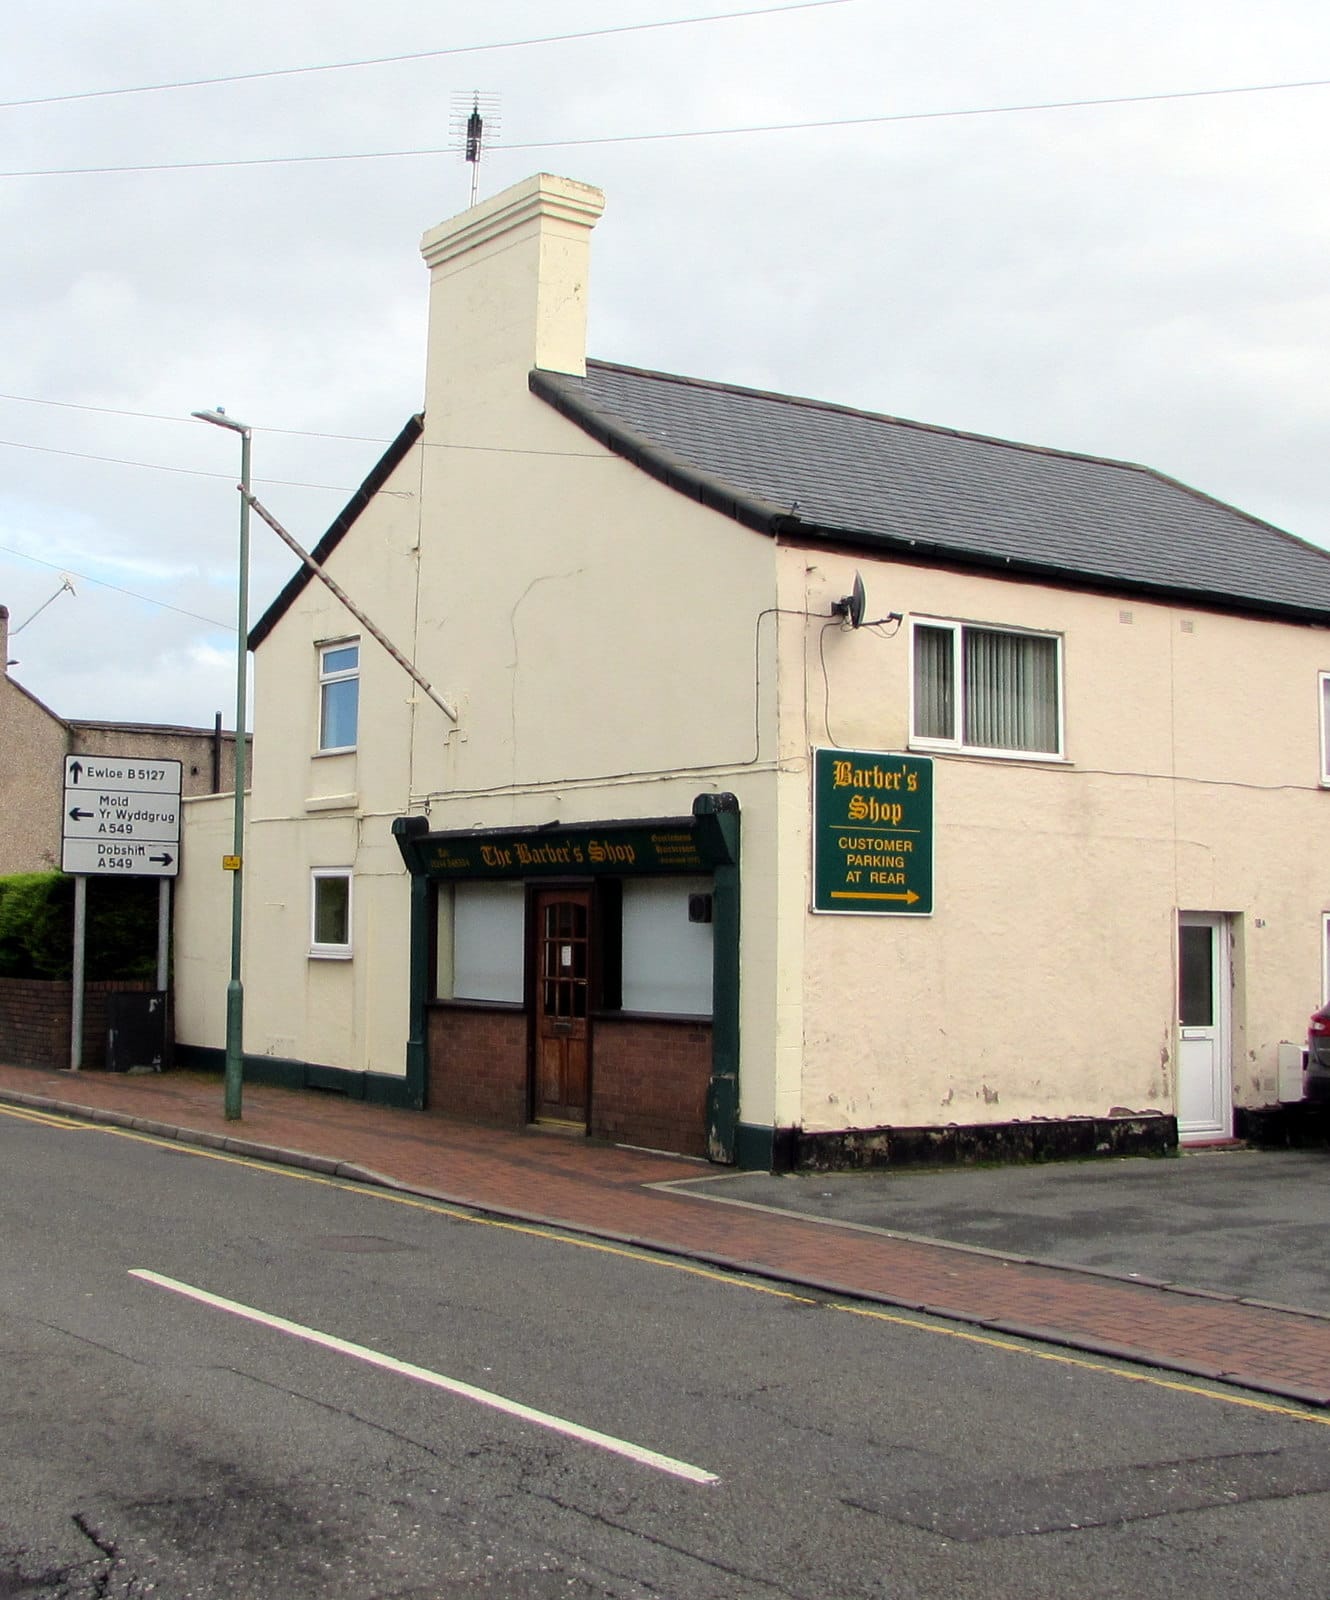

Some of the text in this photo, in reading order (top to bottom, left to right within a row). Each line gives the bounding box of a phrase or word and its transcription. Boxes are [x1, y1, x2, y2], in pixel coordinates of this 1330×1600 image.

[87, 767, 123, 779] Ewloe
[832, 761, 918, 791] Barber's
[99, 796, 129, 807] Mold
[99, 809, 175, 823] Yr Wyddgrug
[848, 795, 903, 826] Shop
[838, 837, 913, 852] CUSTOMER
[480, 844, 512, 868] The
[513, 840, 584, 868] Barber's
[588, 839, 636, 864] Shop
[847, 855, 905, 868] PARKING
[845, 871, 905, 884] AT REAR
